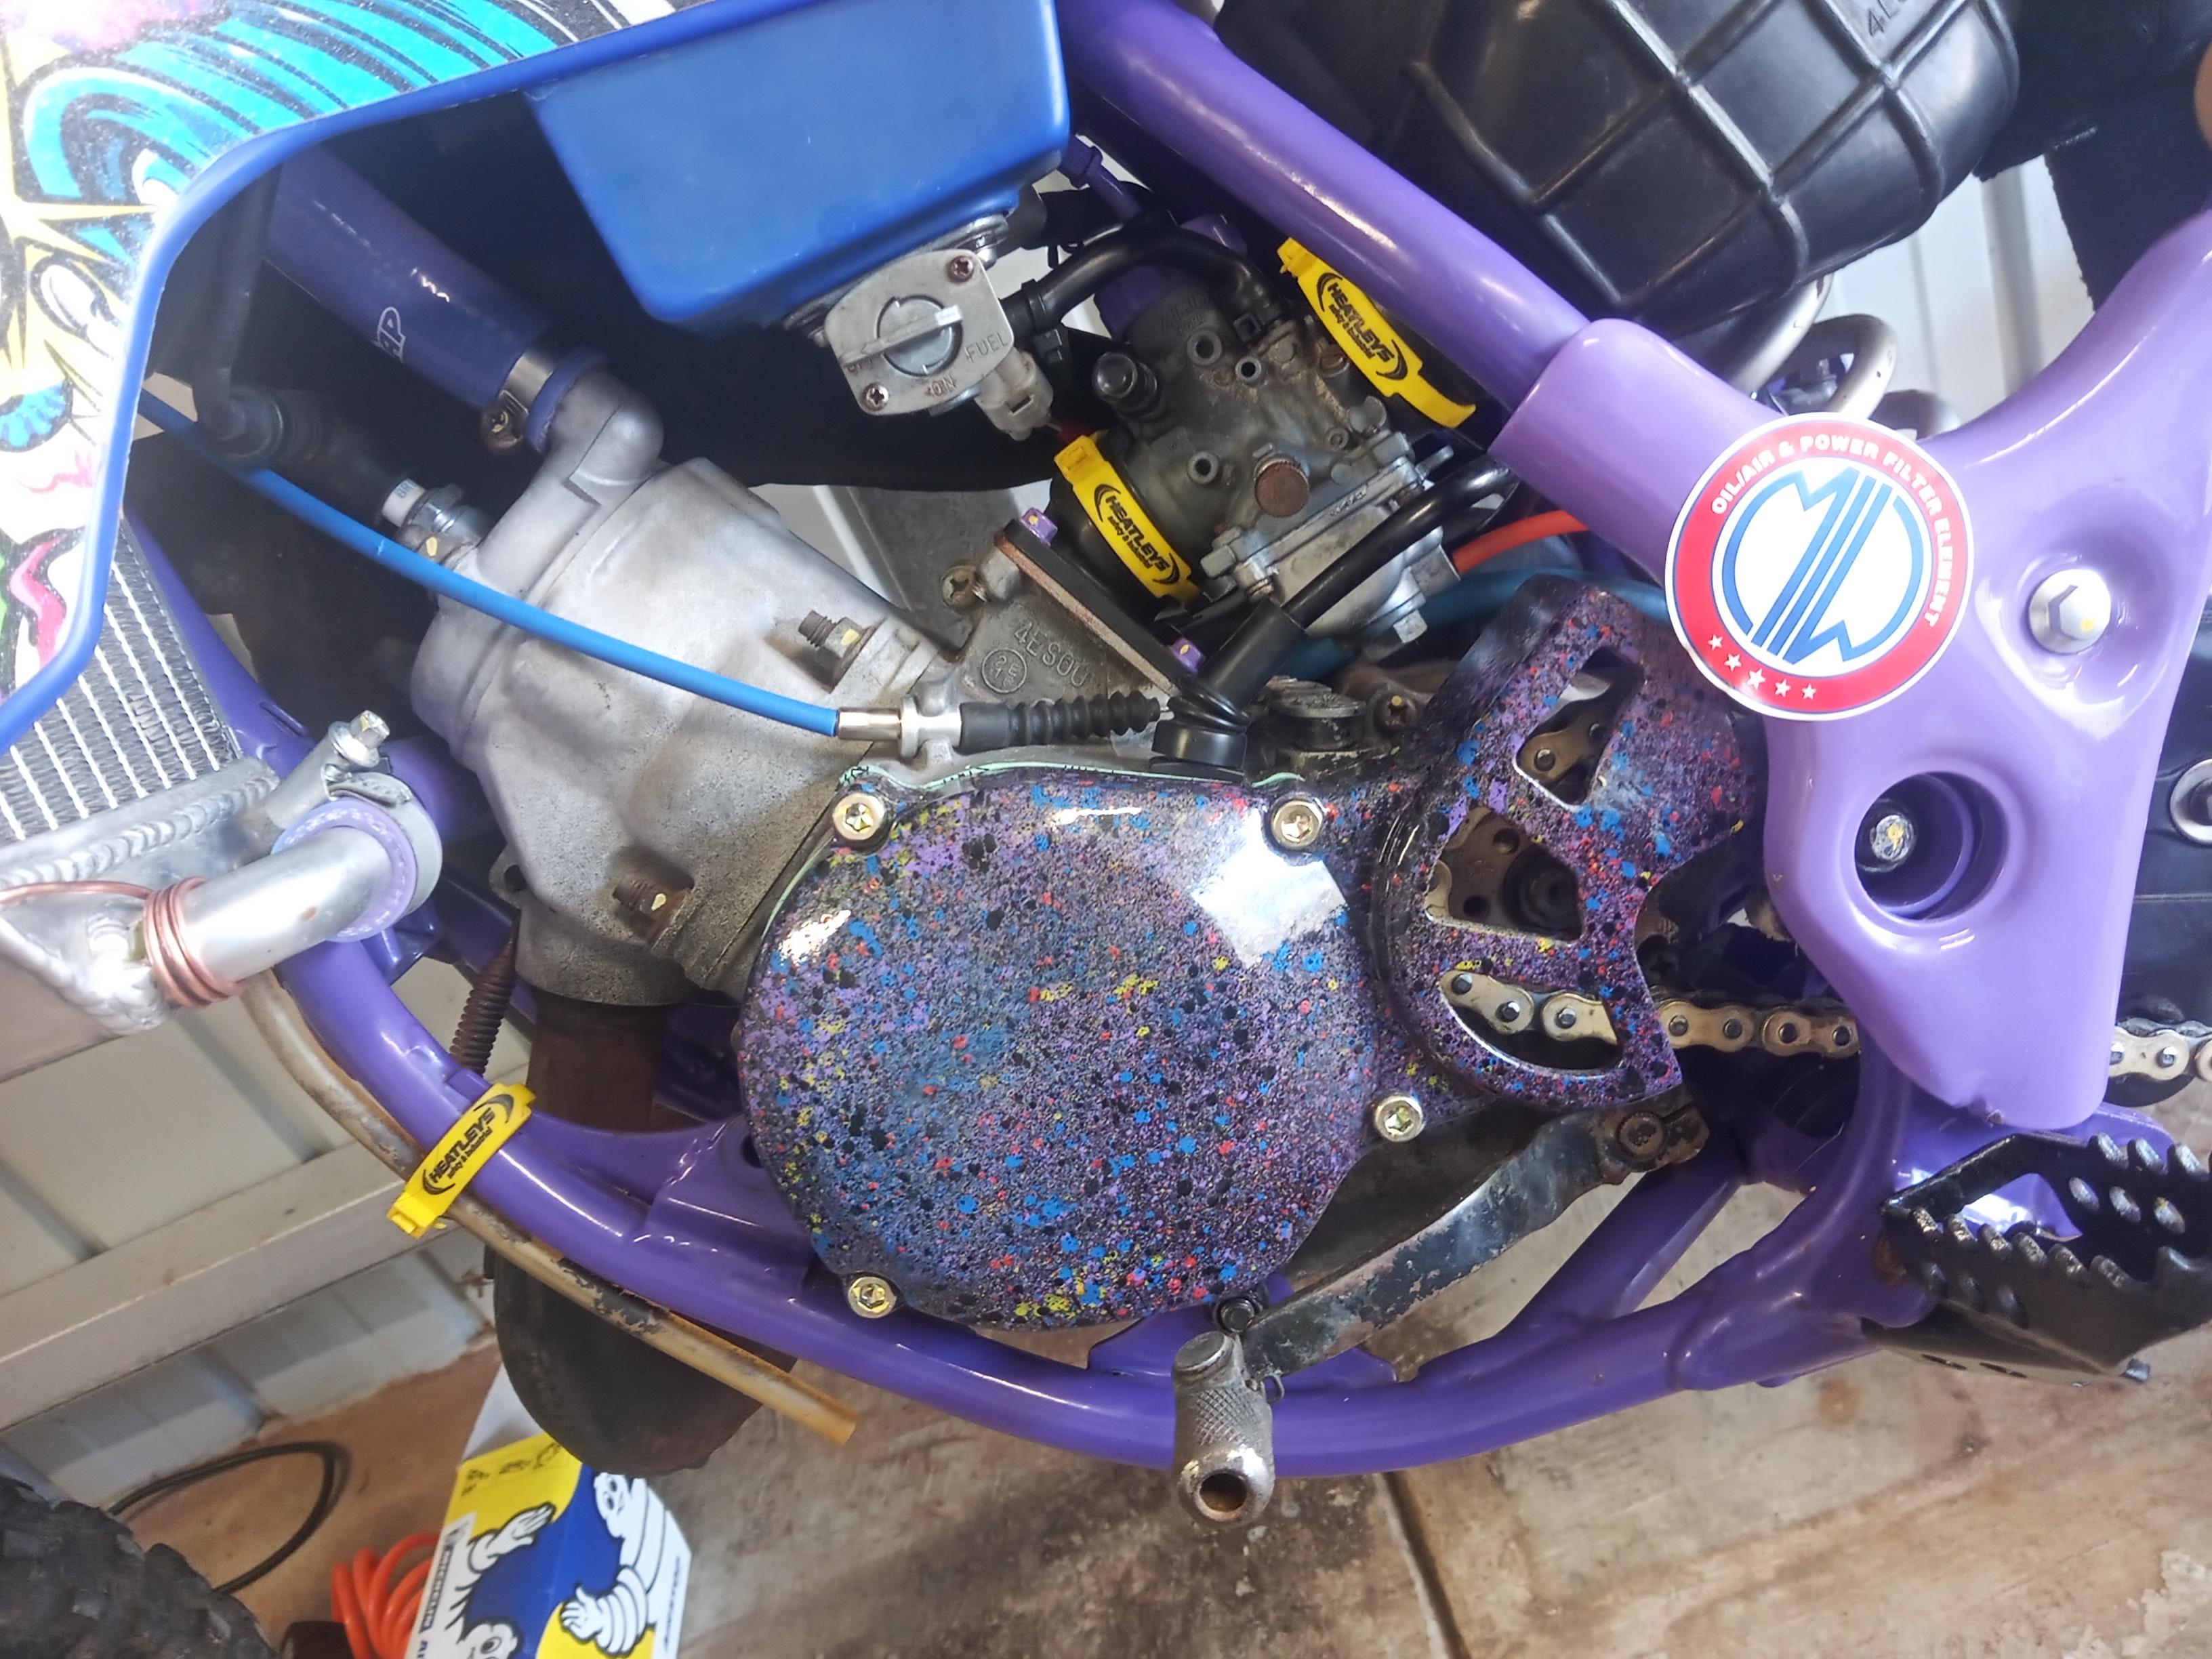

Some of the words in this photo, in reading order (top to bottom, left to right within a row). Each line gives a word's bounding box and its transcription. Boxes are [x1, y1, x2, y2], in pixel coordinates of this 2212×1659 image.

[964, 332, 1008, 363] FUEL
[1328, 282, 1395, 363] HEATLEYS
[1105, 495, 1170, 571] HEATLEYS
[1711, 449, 1776, 514] OIL/AIR
[1778, 441, 1795, 457] &
[1800, 434, 1879, 460] POWER
[1883, 451, 1942, 516] FILTER
[1923, 518, 1953, 628] ELEMENT
[429, 1107, 495, 1183] HEATLEYS
